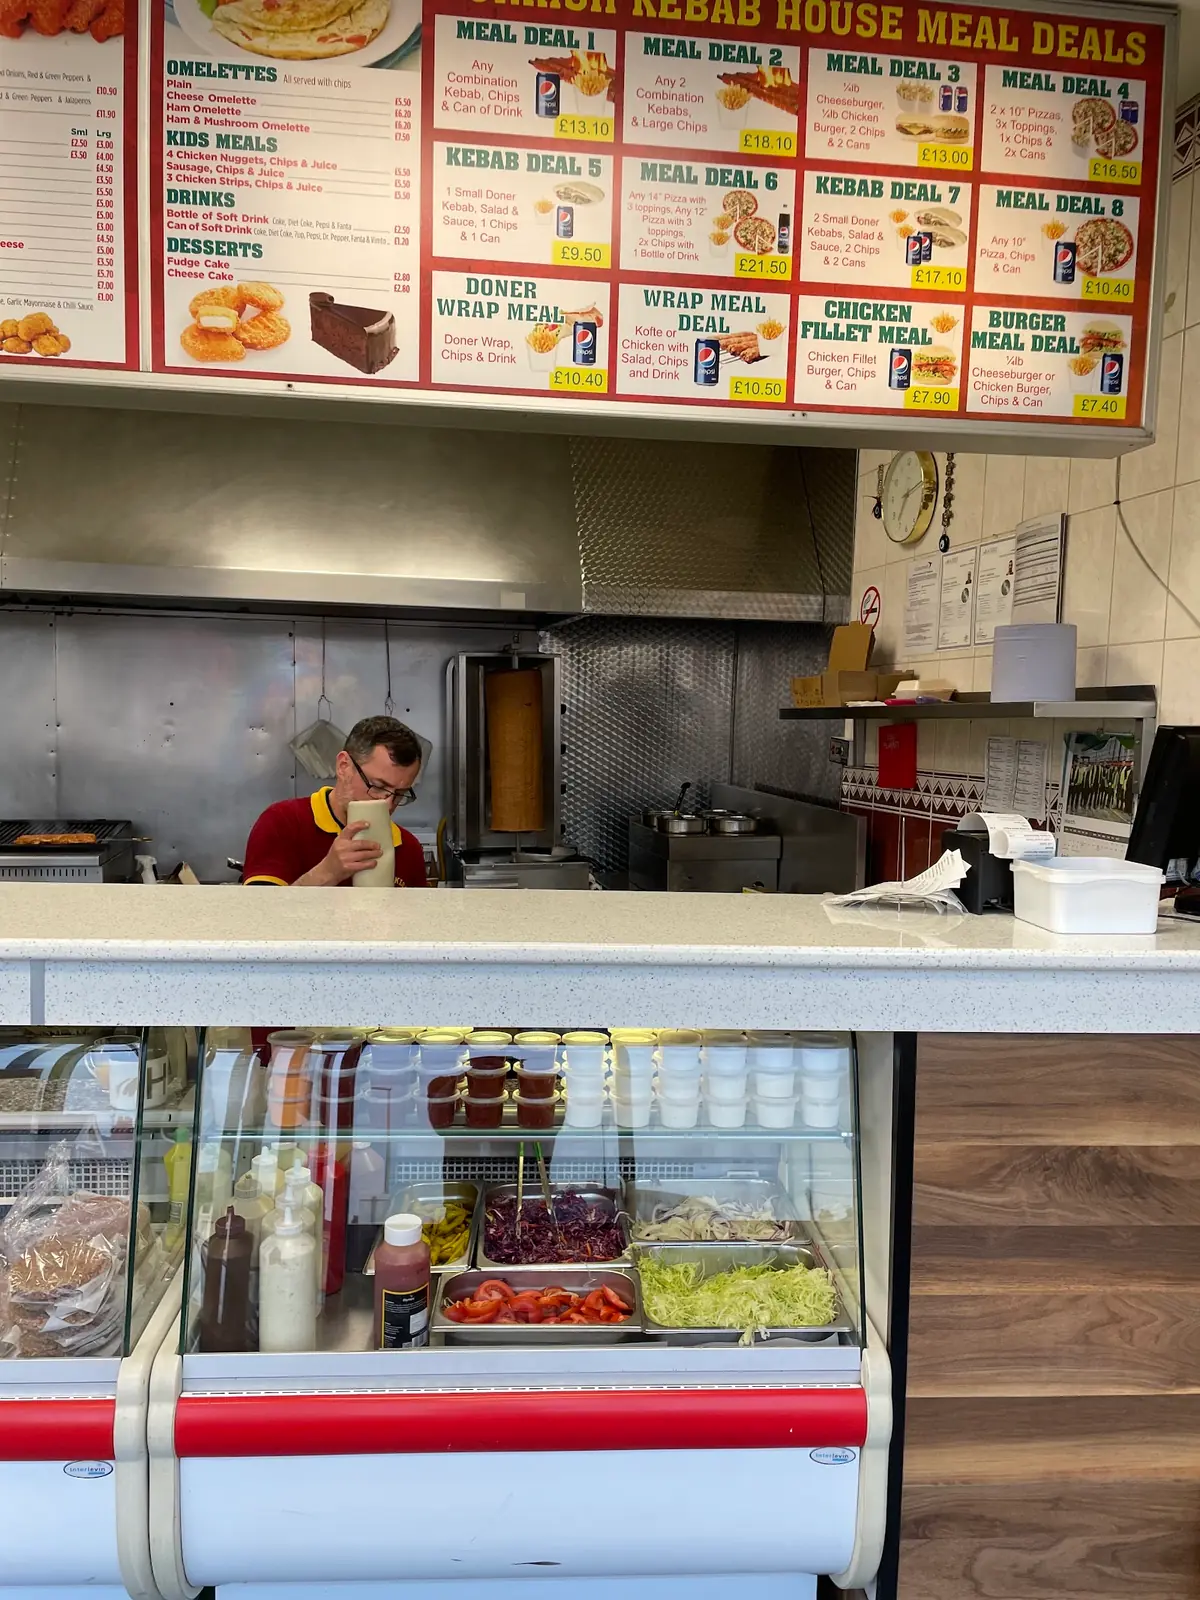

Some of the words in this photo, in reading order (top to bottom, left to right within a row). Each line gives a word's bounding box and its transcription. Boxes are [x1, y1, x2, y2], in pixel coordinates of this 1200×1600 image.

[456, 20, 517, 44] MEAL
[524, 26, 580, 50] DEAL
[776, 0, 903, 40] HOUSE
[917, 8, 1018, 53] MEAL
[1032, 21, 1146, 66] DEALS
[643, 36, 701, 60] MEAL
[708, 42, 762, 65] DEAL
[768, 48, 782, 66] 2
[167, 60, 278, 82] OMELETTES
[283, 74, 292, 84] All
[293, 76, 316, 86] served
[318, 77, 333, 87] with
[334, 79, 352, 89] chips
[472, 59, 494, 74] Any
[827, 53, 883, 76] MEAL
[888, 59, 941, 81] DEAL
[947, 64, 961, 83] 3
[167, 80, 192, 89] Plain
[447, 72, 518, 88] Combination
[1002, 70, 1056, 92] MEAL
[1062, 75, 1112, 98] DEAL
[1117, 81, 1129, 99] 4
[96, 86, 117, 96] £10.90
[167, 92, 204, 101] Cheese
[208, 94, 257, 105] Omelette
[444, 86, 484, 102] Kebab,
[488, 90, 520, 104] Chips
[96, 109, 116, 119] £11.90
[167, 103, 190, 112] Ham
[193, 105, 241, 116] Omelette
[441, 101, 449, 112] &
[453, 102, 476, 114] Can
[480, 104, 491, 115] of
[494, 105, 523, 118] Drink
[167, 115, 190, 124] Ham
[204, 117, 258, 129] Mushroom
[262, 121, 310, 133] Omelette
[559, 119, 609, 136] £13.10
[71, 128, 88, 136] Sml
[96, 130, 111, 138] Lrg
[167, 130, 209, 147] KIDS
[216, 133, 278, 152] MEALS
[743, 132, 792, 150] £18.10
[71, 139, 88, 147] £2.50
[96, 140, 113, 149] £3.00
[96, 152, 113, 161] £4.00
[167, 150, 173, 158] 4
[176, 151, 217, 161] Chicken
[220, 153, 267, 166] Nuggets,
[269, 157, 298, 169] Chips
[301, 159, 308, 167] &
[311, 160, 338, 170] Juice
[446, 146, 519, 171] KEBAB
[526, 152, 581, 176] DEAL
[588, 158, 602, 177] 5
[922, 147, 969, 165] £13.00
[96, 164, 113, 173] £4.50
[167, 162, 212, 174] Sausage,
[216, 165, 244, 176] Chips
[247, 167, 254, 175] &
[258, 168, 284, 178] Juice
[640, 162, 698, 184] MEAL
[705, 167, 759, 189] DEAL
[764, 172, 778, 191] 6
[1092, 162, 1138, 180] £16.50
[176, 174, 216, 184] Chicken
[219, 177, 252, 189] Strips,
[255, 180, 283, 191] Chips
[286, 182, 293, 190] &
[296, 182, 323, 193] Juice
[816, 176, 883, 198] KEBAB
[890, 181, 942, 203] DEAL
[948, 186, 961, 204] 7
[167, 188, 236, 208] DRINKS
[996, 189, 1049, 211] MEAL
[1056, 195, 1106, 216] DEAL
[1111, 200, 1124, 217] 8
[167, 209, 198, 219] Bottle
[202, 211, 213, 220] of
[216, 212, 238, 222] Soft
[241, 214, 269, 224] Drink
[167, 221, 186, 230] Can
[189, 222, 200, 231] of
[202, 223, 223, 232] Soft
[225, 225, 252, 235] Drink
[167, 237, 263, 259] DESSERTS
[560, 245, 602, 262] £9.50
[167, 257, 200, 268] Fudge
[204, 259, 230, 269] Cake
[738, 257, 787, 275] £21.50
[167, 269, 204, 279] Cheese
[208, 271, 234, 281] Cake
[915, 270, 962, 286] £17.10
[466, 277, 537, 299] DONER
[1085, 281, 1130, 297] £10.40
[644, 289, 703, 310] WRAP
[711, 293, 766, 314] MEAL
[436, 298, 500, 320] WRAP
[507, 302, 565, 324] MEAL
[824, 301, 912, 323] CHICKEN
[678, 314, 730, 334] DEAL
[988, 311, 1065, 332] BURGER
[635, 326, 665, 338] Kofte
[667, 329, 677, 338] or
[801, 321, 873, 343] FILLET
[878, 326, 933, 346] MEAL
[444, 334, 478, 348] Doner
[481, 336, 513, 351] Wrap,
[621, 338, 665, 352] Chicken
[668, 341, 688, 353] with
[971, 331, 1024, 352] MEAL
[1031, 334, 1080, 354] DEAL
[441, 349, 474, 363] Chips
[477, 351, 485, 361] &
[488, 351, 517, 364] Drink
[621, 352, 655, 366] Salad,
[658, 355, 688, 368] Chips
[554, 370, 603, 387] £10.40
[629, 368, 649, 379] and
[652, 369, 680, 380] Drink
[972, 367, 1043, 382] Cheeseburger
[1046, 372, 1055, 381] or
[734, 380, 781, 397] £10.50
[973, 381, 1014, 393] Chicken
[1016, 384, 1052, 397] Burger,
[912, 390, 950, 405] £7.90
[981, 395, 1008, 407] Chips
[1012, 397, 1020, 406] &
[1022, 397, 1043, 408] Can
[1081, 398, 1117, 414] £7.40
